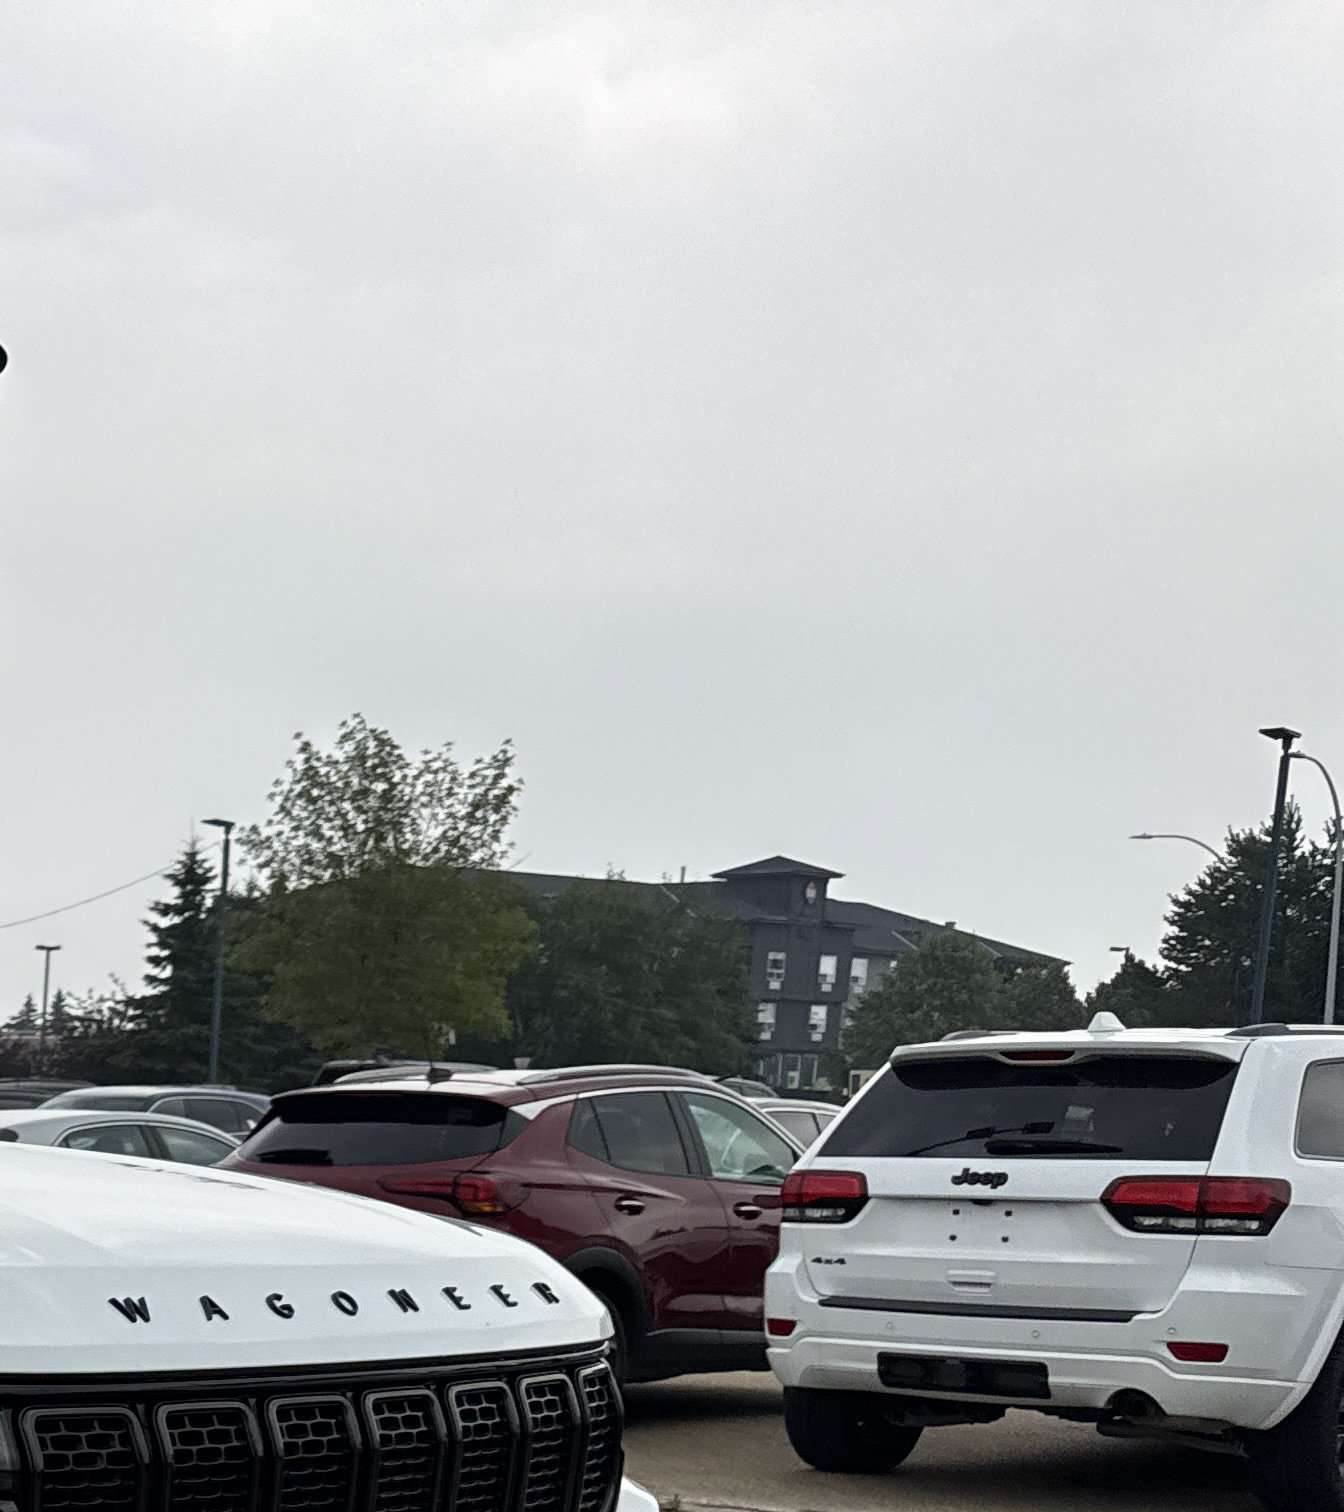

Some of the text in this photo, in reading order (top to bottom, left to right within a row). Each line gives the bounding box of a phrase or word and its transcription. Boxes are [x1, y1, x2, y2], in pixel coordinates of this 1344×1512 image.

[951, 1168, 1009, 1190] Jeep
[812, 1257, 846, 1265] 4x4
[108, 1282, 560, 1323] WAGONEER
